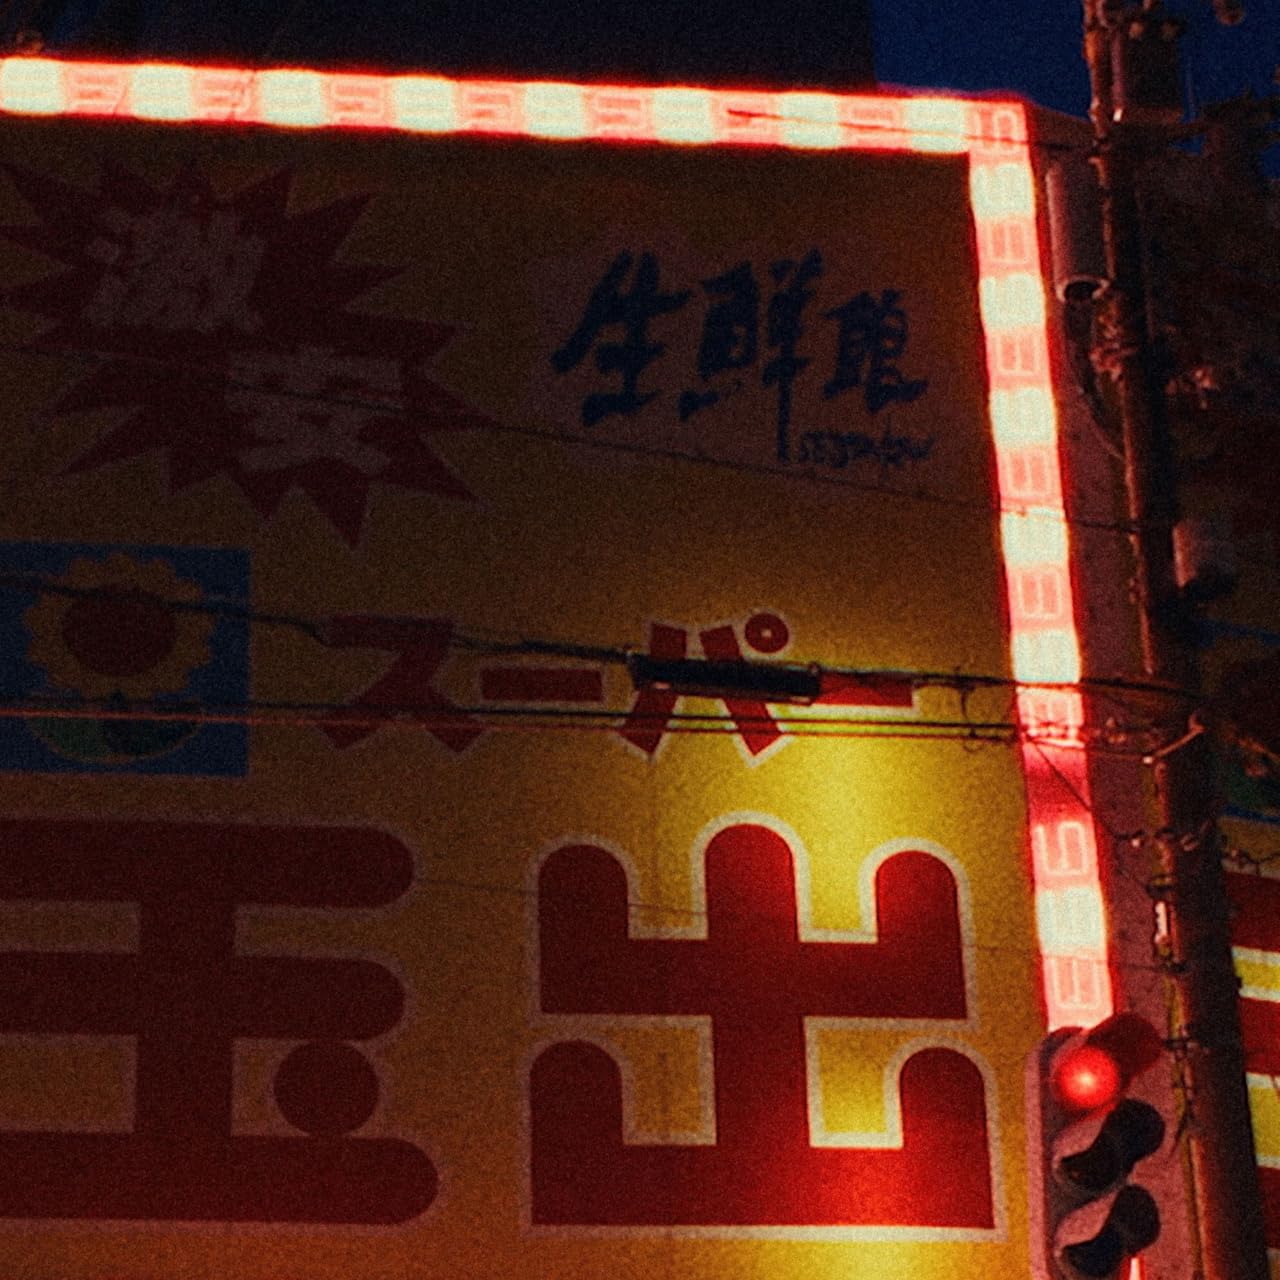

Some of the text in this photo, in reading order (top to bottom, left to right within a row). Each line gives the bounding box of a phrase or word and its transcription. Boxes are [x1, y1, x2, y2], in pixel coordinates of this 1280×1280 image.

[551, 247, 930, 463] 生鮮館
[320, 612, 914, 762] スーパー
